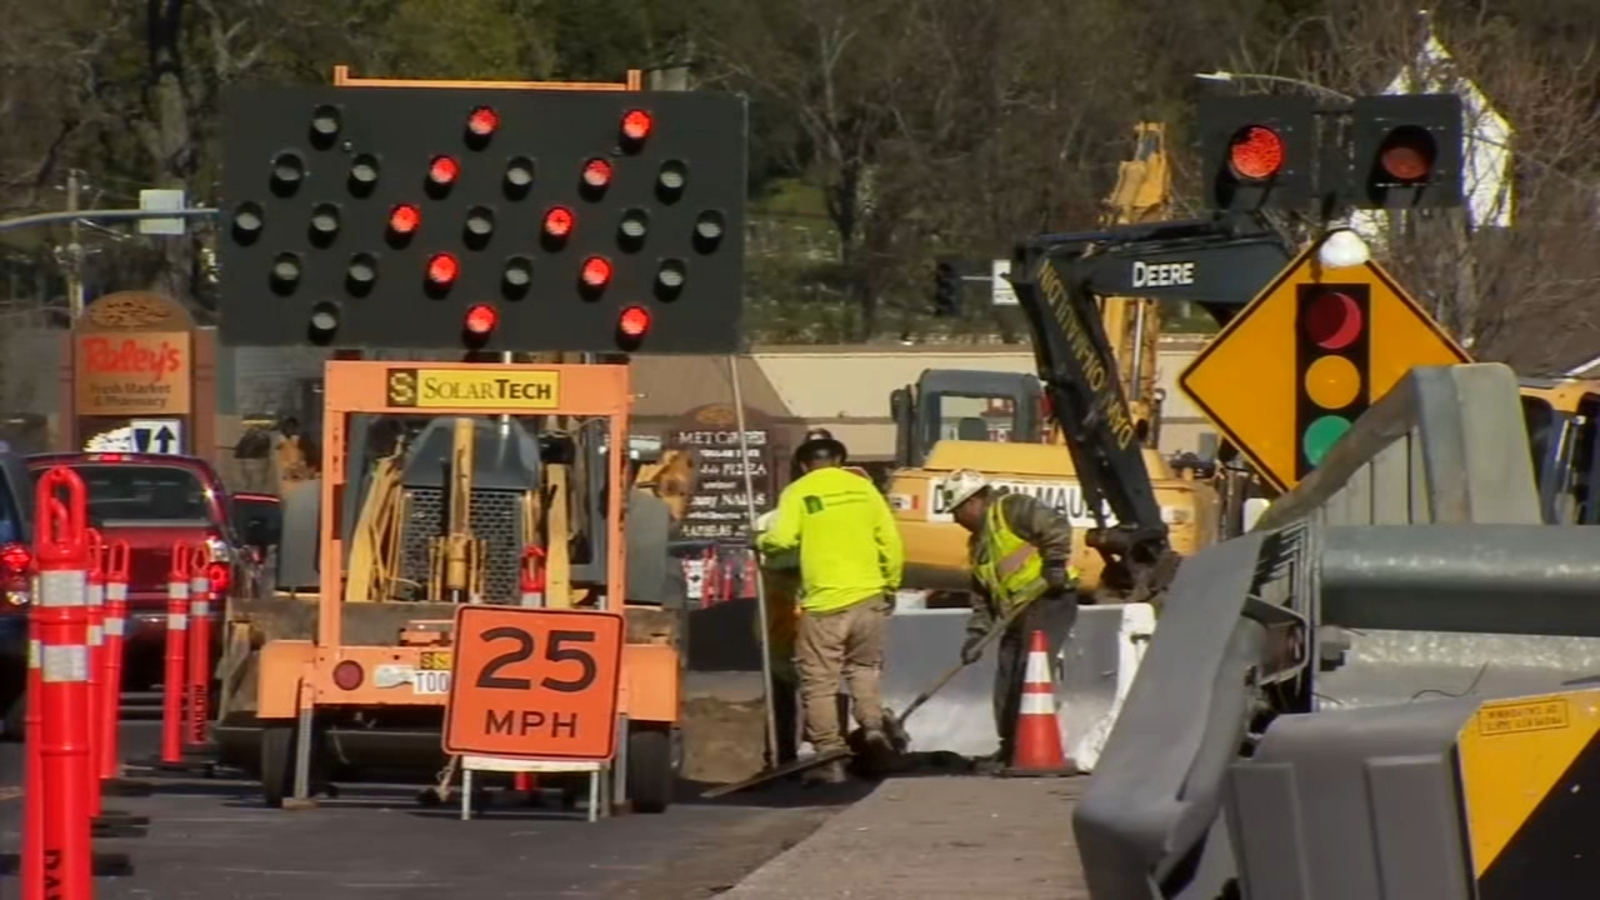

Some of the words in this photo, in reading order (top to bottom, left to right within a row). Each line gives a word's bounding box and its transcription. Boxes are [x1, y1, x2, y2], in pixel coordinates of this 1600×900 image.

[1133, 261, 1195, 288] DEERE
[476, 627, 597, 692] 25
[485, 709, 578, 738] MPH
